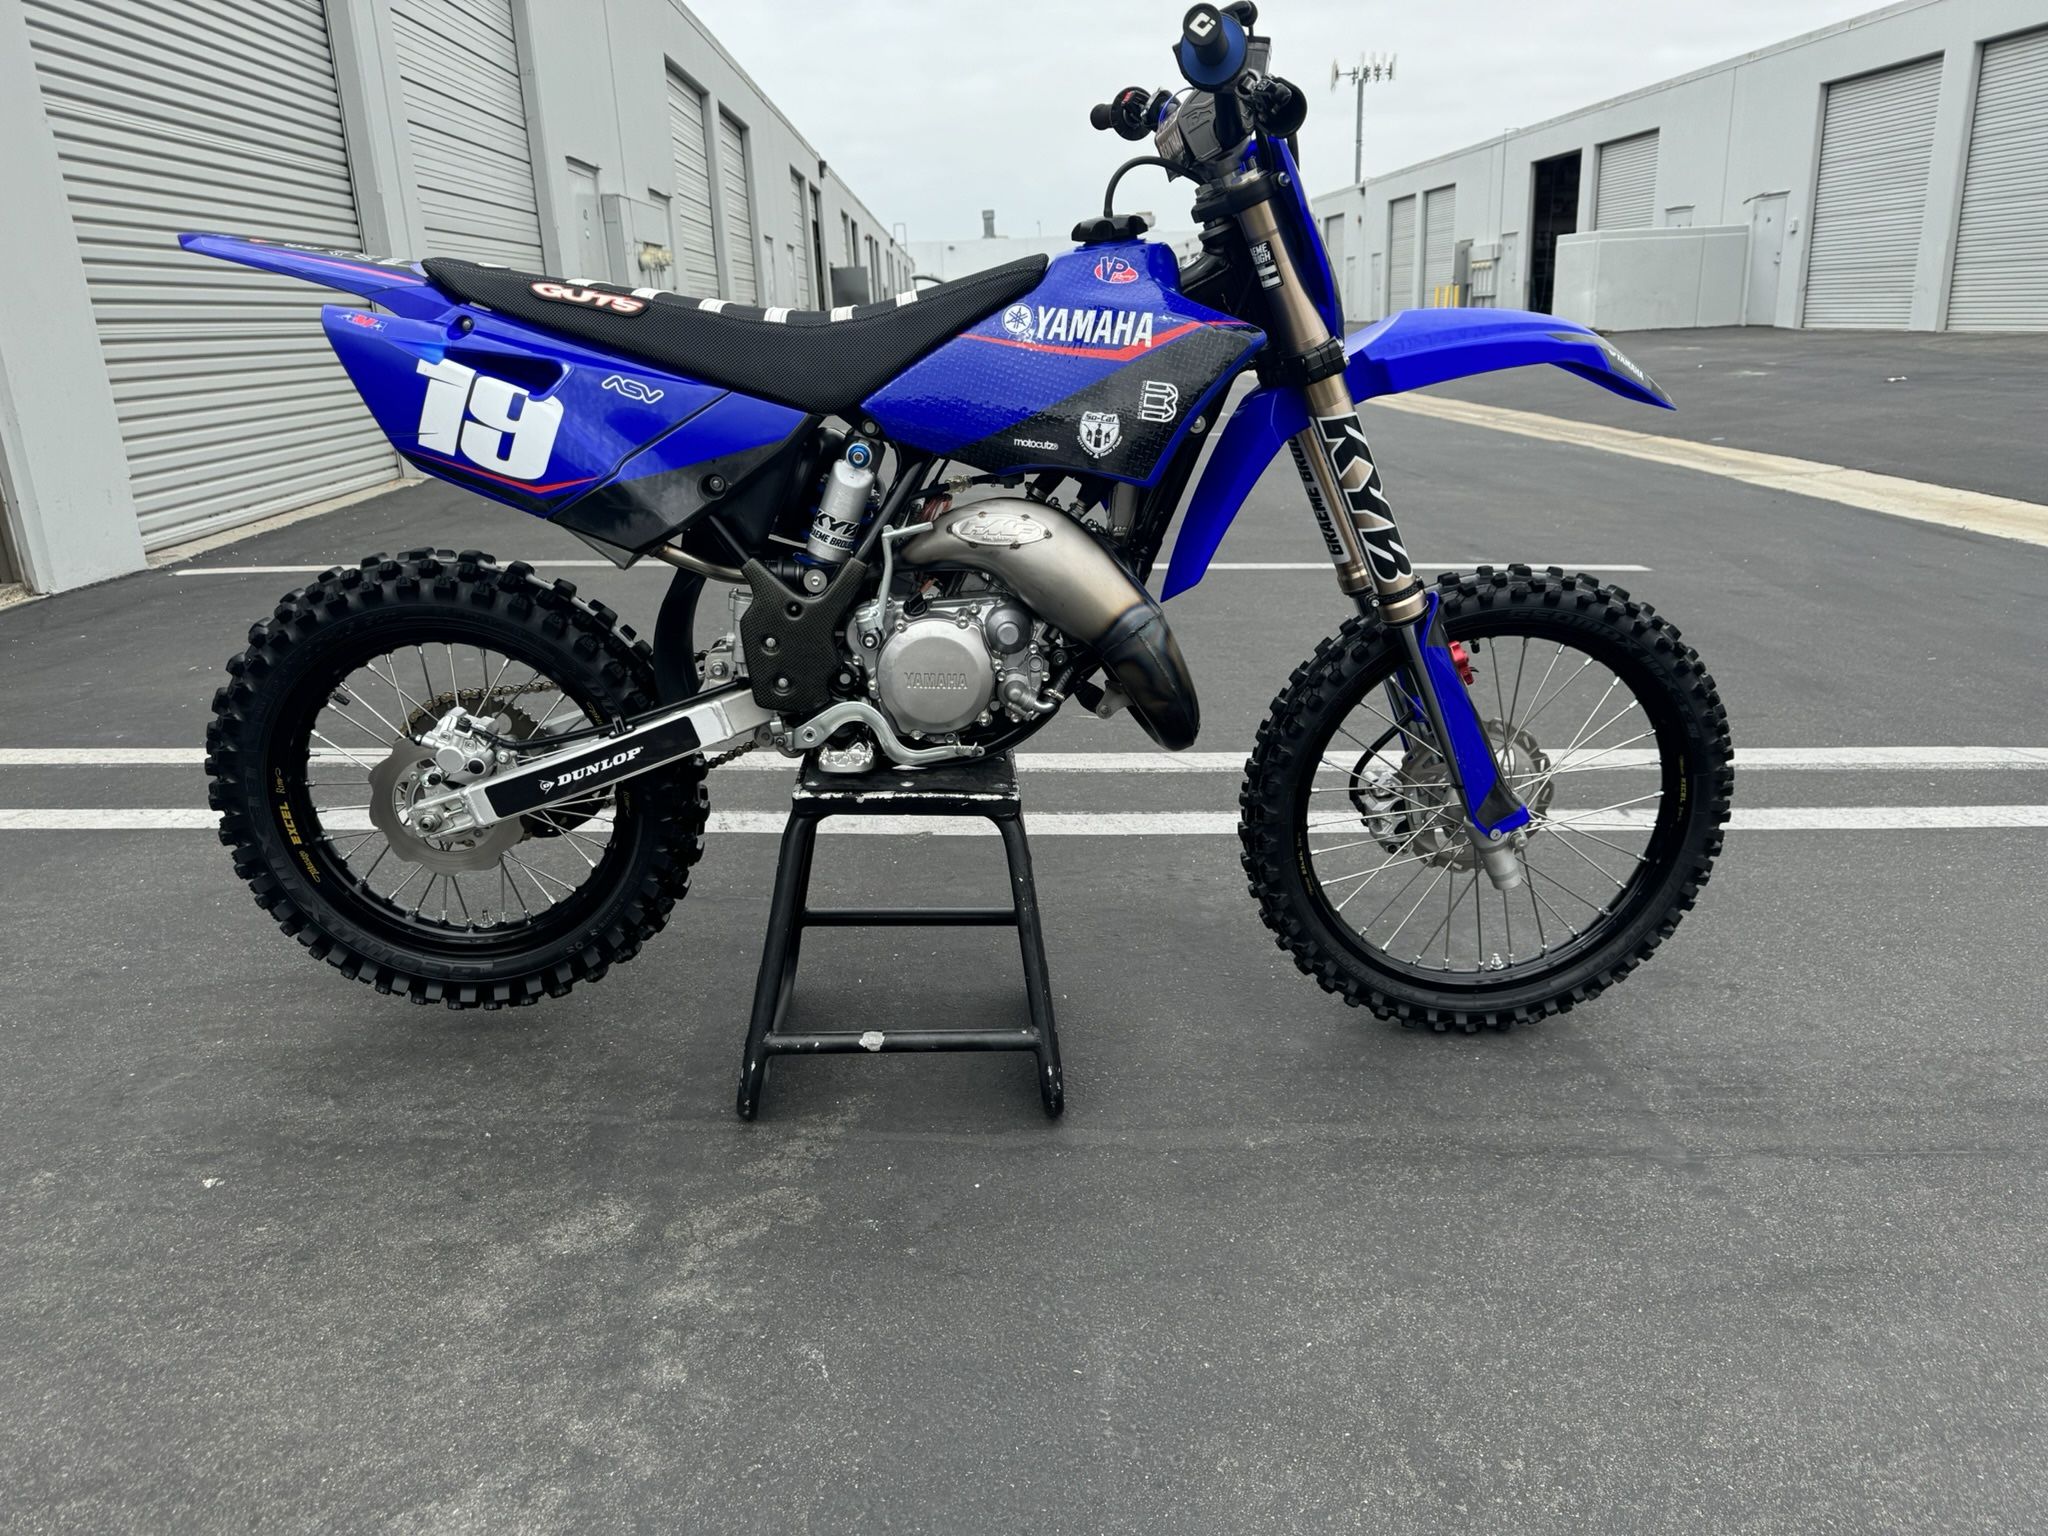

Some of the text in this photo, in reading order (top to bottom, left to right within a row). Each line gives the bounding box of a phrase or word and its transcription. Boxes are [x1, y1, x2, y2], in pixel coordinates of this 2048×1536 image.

[1100, 256, 1129, 283] VP
[531, 282, 644, 313] GUTS
[1037, 306, 1153, 347] YAMAHA
[601, 375, 664, 404] ASV
[416, 358, 565, 480] 19
[1086, 413, 1116, 423] So-Cal
[1014, 438, 1055, 450] motocutz
[1317, 412, 1414, 583] KYB
[1308, 487, 1344, 556] GRAEME
[904, 671, 968, 690] YAMAHA
[557, 746, 641, 786] DUNLOP
[280, 801, 303, 846] EXCEL
